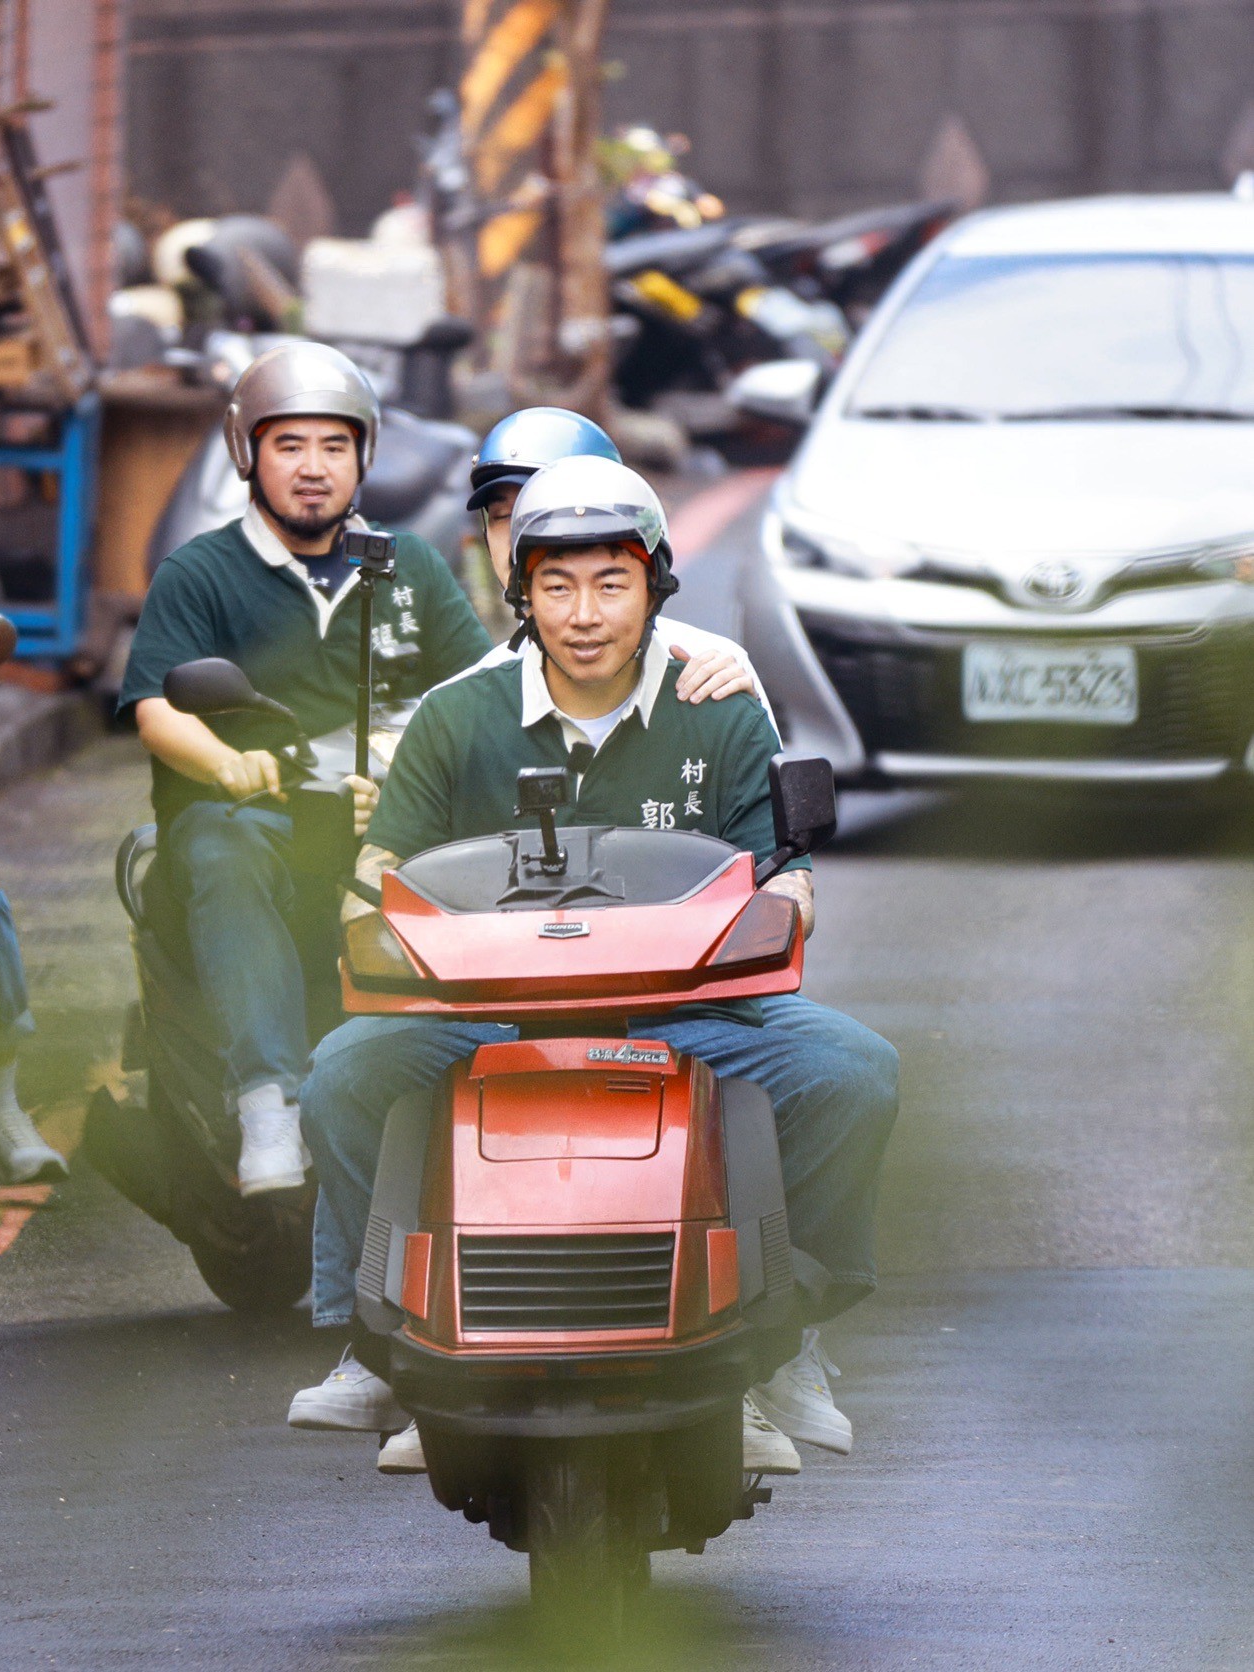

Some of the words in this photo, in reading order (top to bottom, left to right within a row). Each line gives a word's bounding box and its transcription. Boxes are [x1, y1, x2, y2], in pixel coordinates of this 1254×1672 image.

[392, 585, 420, 634] 村長
[680, 758, 707, 816] 村長
[641, 798, 675, 829] 郭
[545, 923, 582, 931] HONDA
